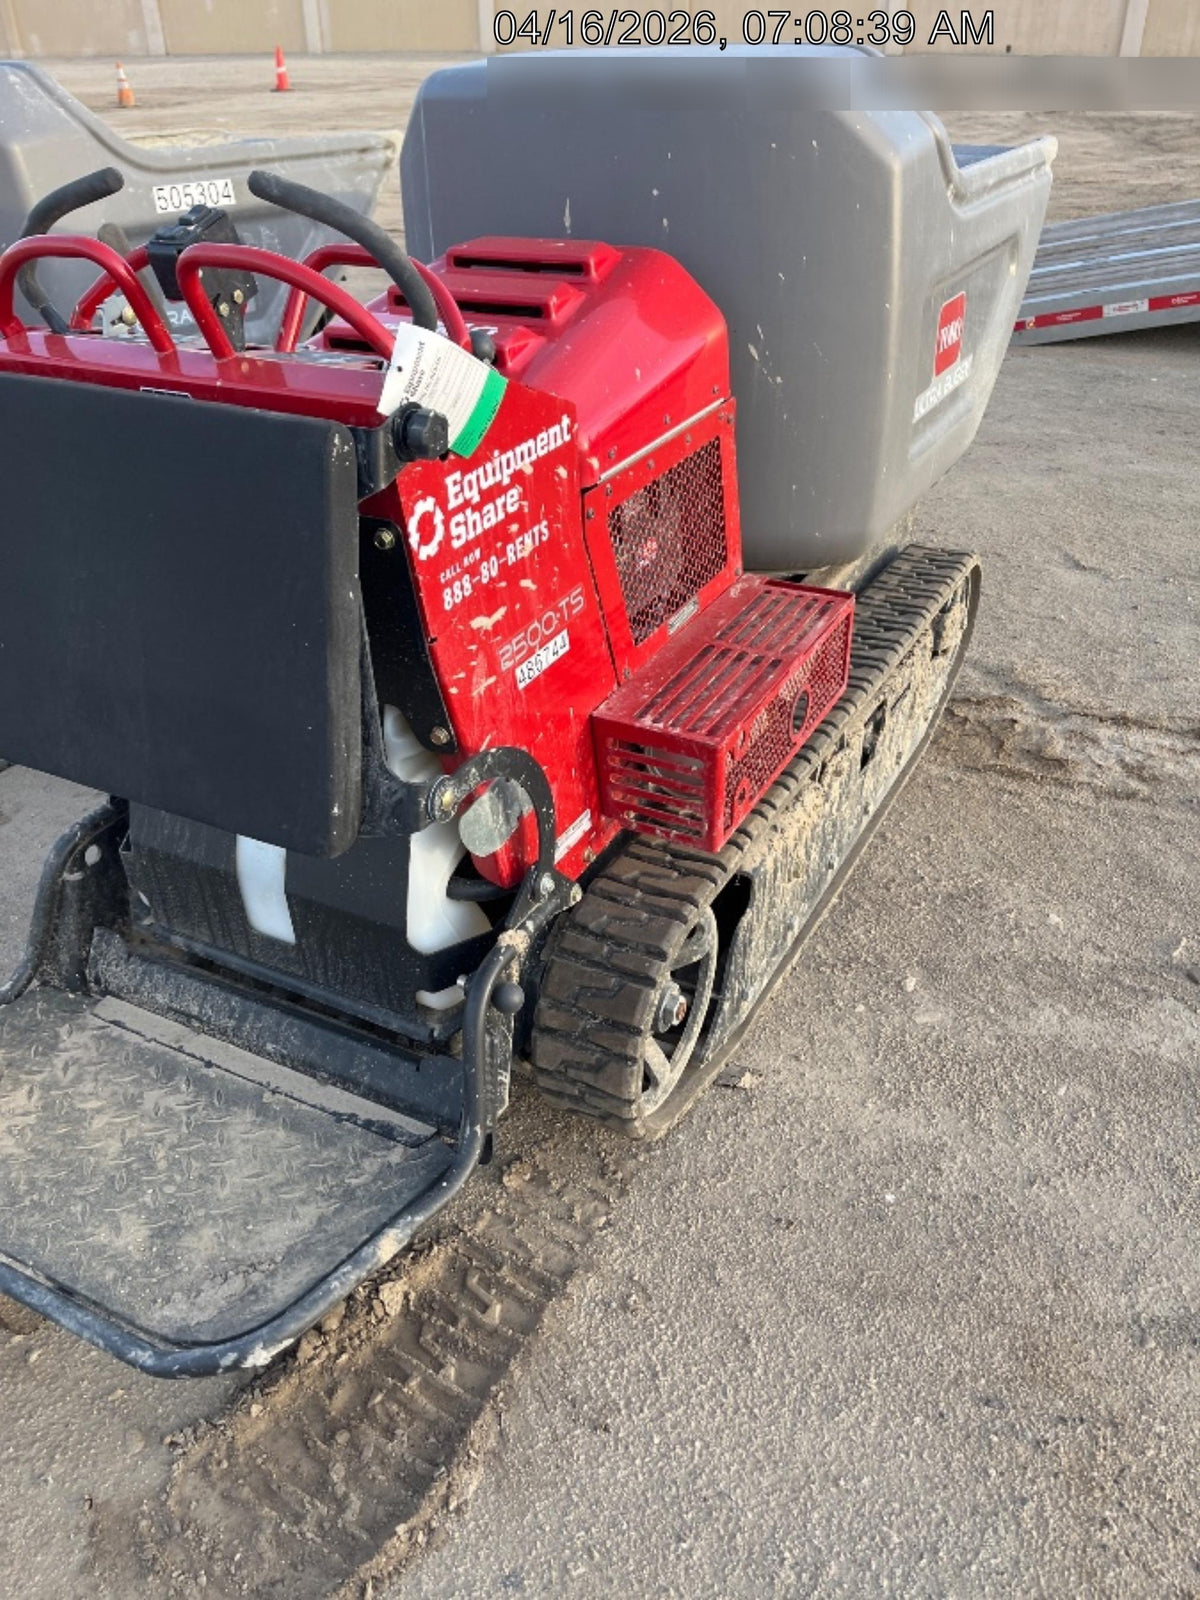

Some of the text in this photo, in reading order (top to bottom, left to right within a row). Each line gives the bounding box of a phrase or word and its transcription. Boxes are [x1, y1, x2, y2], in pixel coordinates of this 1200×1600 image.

[155, 182, 233, 211] 505304
[445, 414, 571, 510] Equipment
[450, 487, 520, 549] Share
[440, 547, 481, 583] CALL NOW
[443, 520, 549, 610] 888-80-RENTS
